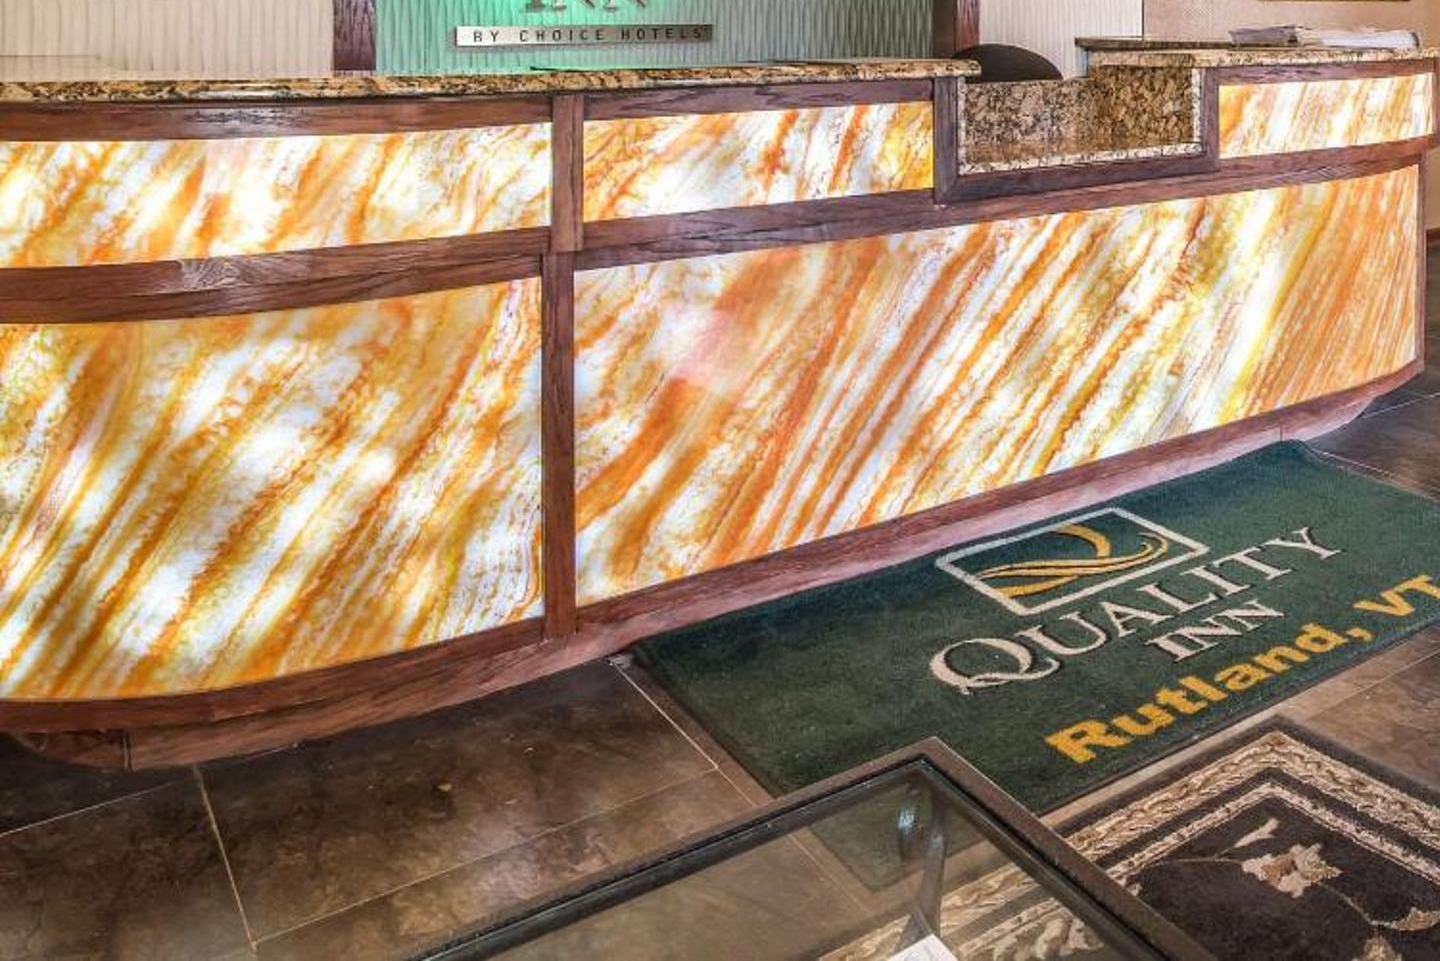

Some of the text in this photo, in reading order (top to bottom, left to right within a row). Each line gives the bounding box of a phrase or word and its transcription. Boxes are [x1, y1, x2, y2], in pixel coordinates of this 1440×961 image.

[472, 27, 703, 43] BY CHOICE HOTELS
[928, 525, 1342, 697] QUALITY
[1144, 597, 1286, 664] INN
[1043, 621, 1375, 766] Rutland,
